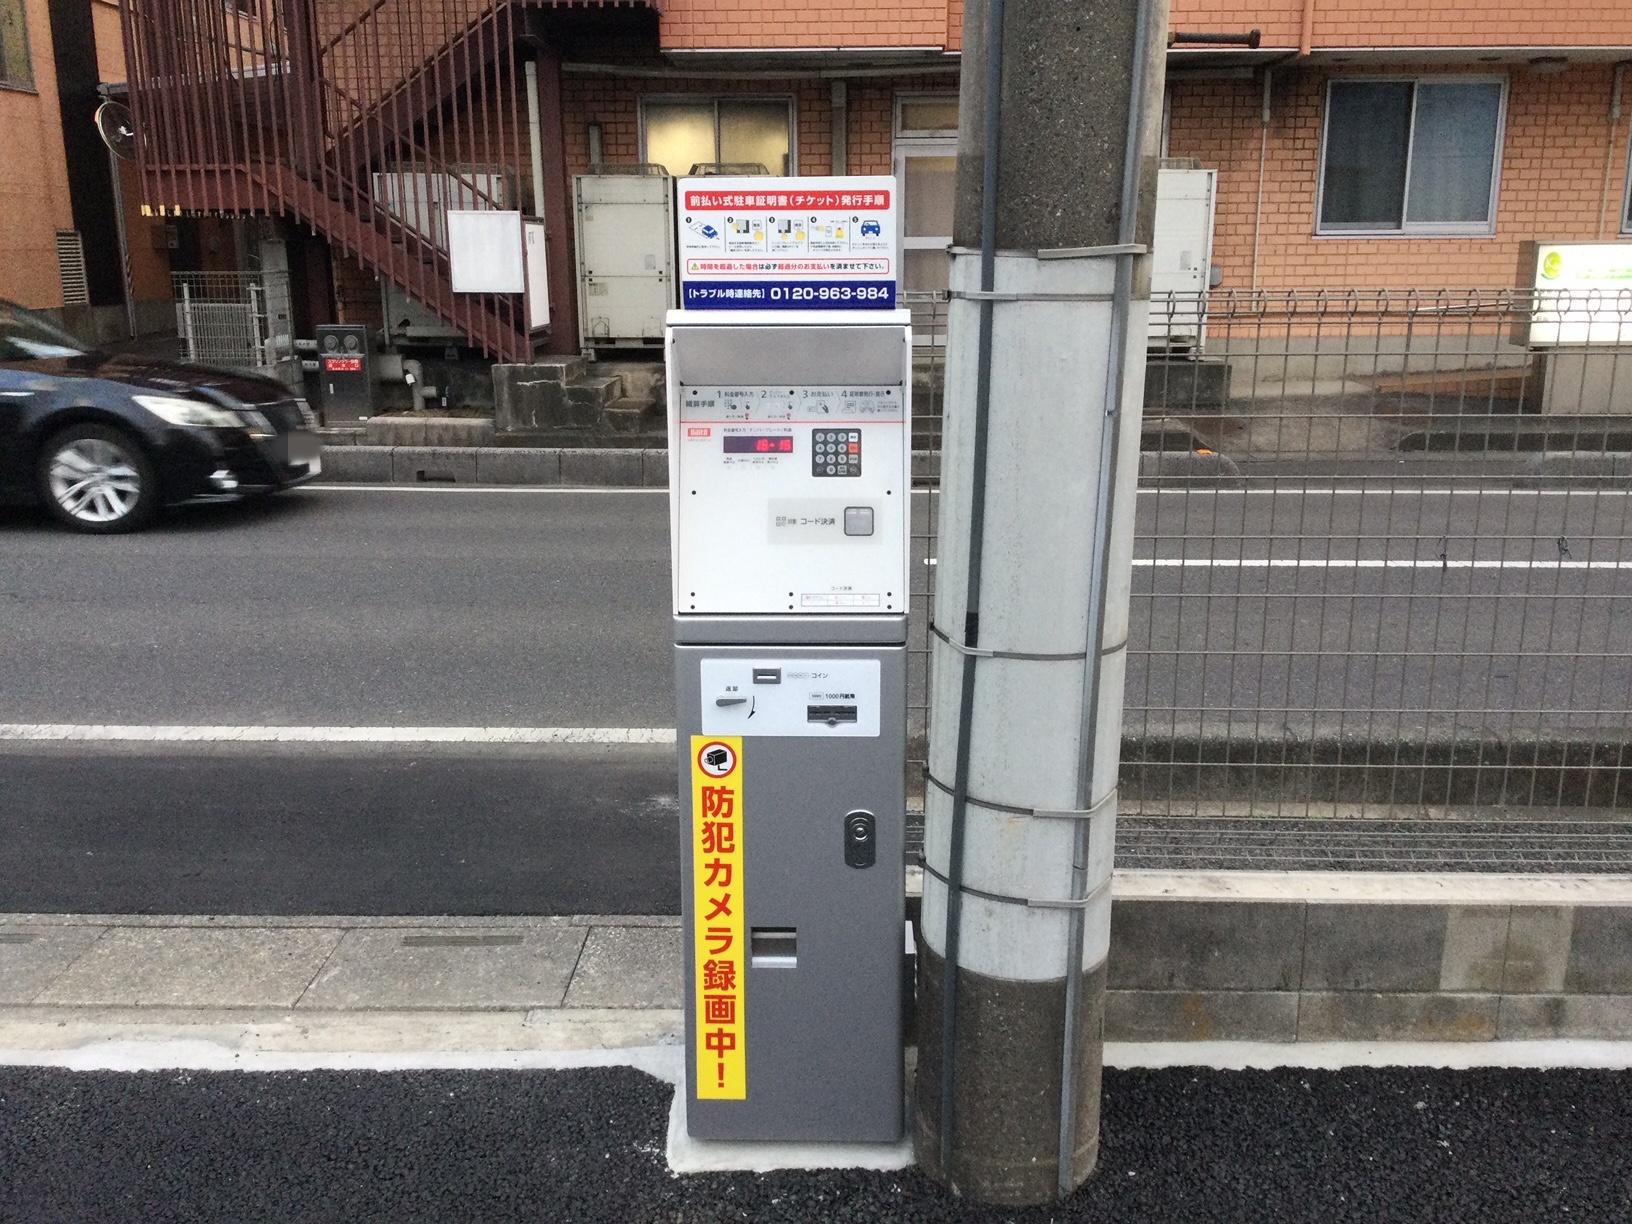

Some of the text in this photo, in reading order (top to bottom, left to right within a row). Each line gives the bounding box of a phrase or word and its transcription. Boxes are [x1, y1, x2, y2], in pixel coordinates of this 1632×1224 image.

[770, 287, 889, 300] 0120-963-984
[702, 786, 736, 1088] 防犯カメラ録画中！
